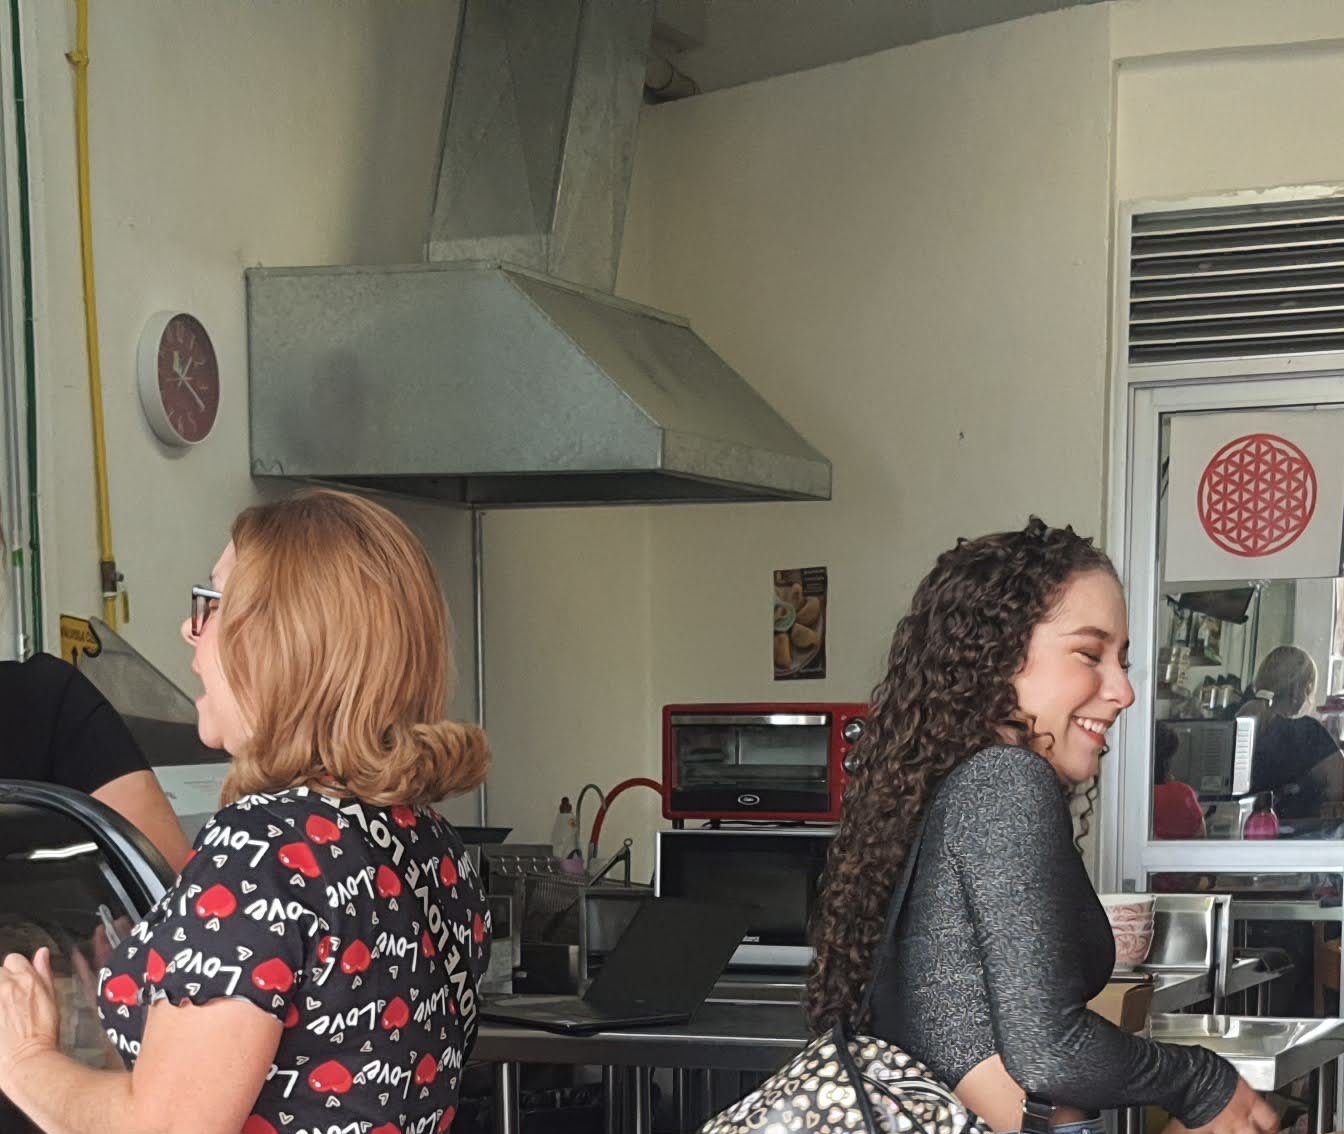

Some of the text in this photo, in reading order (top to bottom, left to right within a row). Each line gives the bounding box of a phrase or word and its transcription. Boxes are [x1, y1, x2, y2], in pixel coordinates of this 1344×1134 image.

[204, 826, 271, 868] Love
[327, 868, 375, 908] Love
[405, 859, 449, 952] LOVE
[244, 897, 319, 937] Love
[174, 947, 242, 995] Love
[375, 931, 418, 972] Love
[307, 1001, 378, 1035] Love
[362, 1060, 412, 1099] Love
